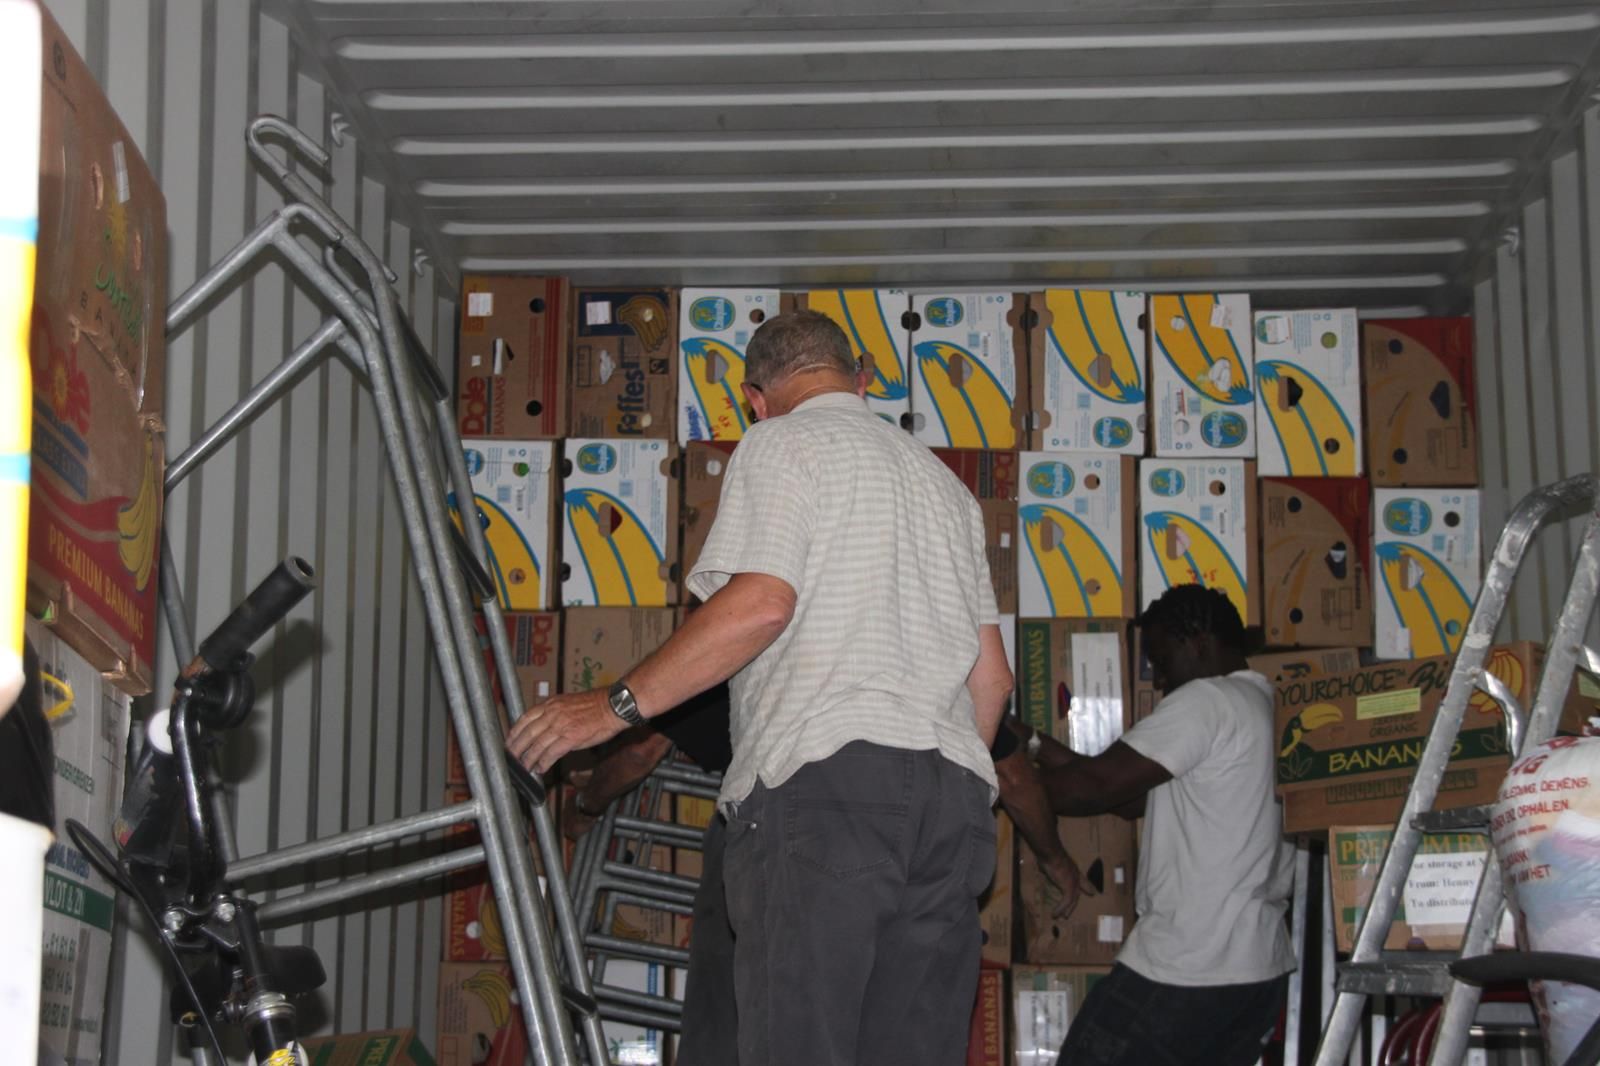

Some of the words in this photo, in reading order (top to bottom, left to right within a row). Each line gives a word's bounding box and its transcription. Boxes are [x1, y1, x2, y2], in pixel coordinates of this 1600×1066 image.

[461, 376, 487, 435] Dole
[493, 377, 506, 435] BANANAS
[993, 453, 1015, 499] Dole
[48, 522, 103, 598] PREMIUM
[104, 575, 144, 640] BANANAS
[532, 615, 553, 667] Dole
[1029, 629, 1045, 702] BANANAS
[1278, 668, 1397, 706] YOURCHOICE
[1408, 660, 1450, 696] Bi
[1369, 722, 1418, 738] ORGANIC
[1328, 738, 1464, 773] BANANS
[1427, 859, 1464, 872] storage
[1466, 859, 1477, 868] at
[1411, 899, 1425, 908] To
[982, 975, 997, 1055] BANANAS
